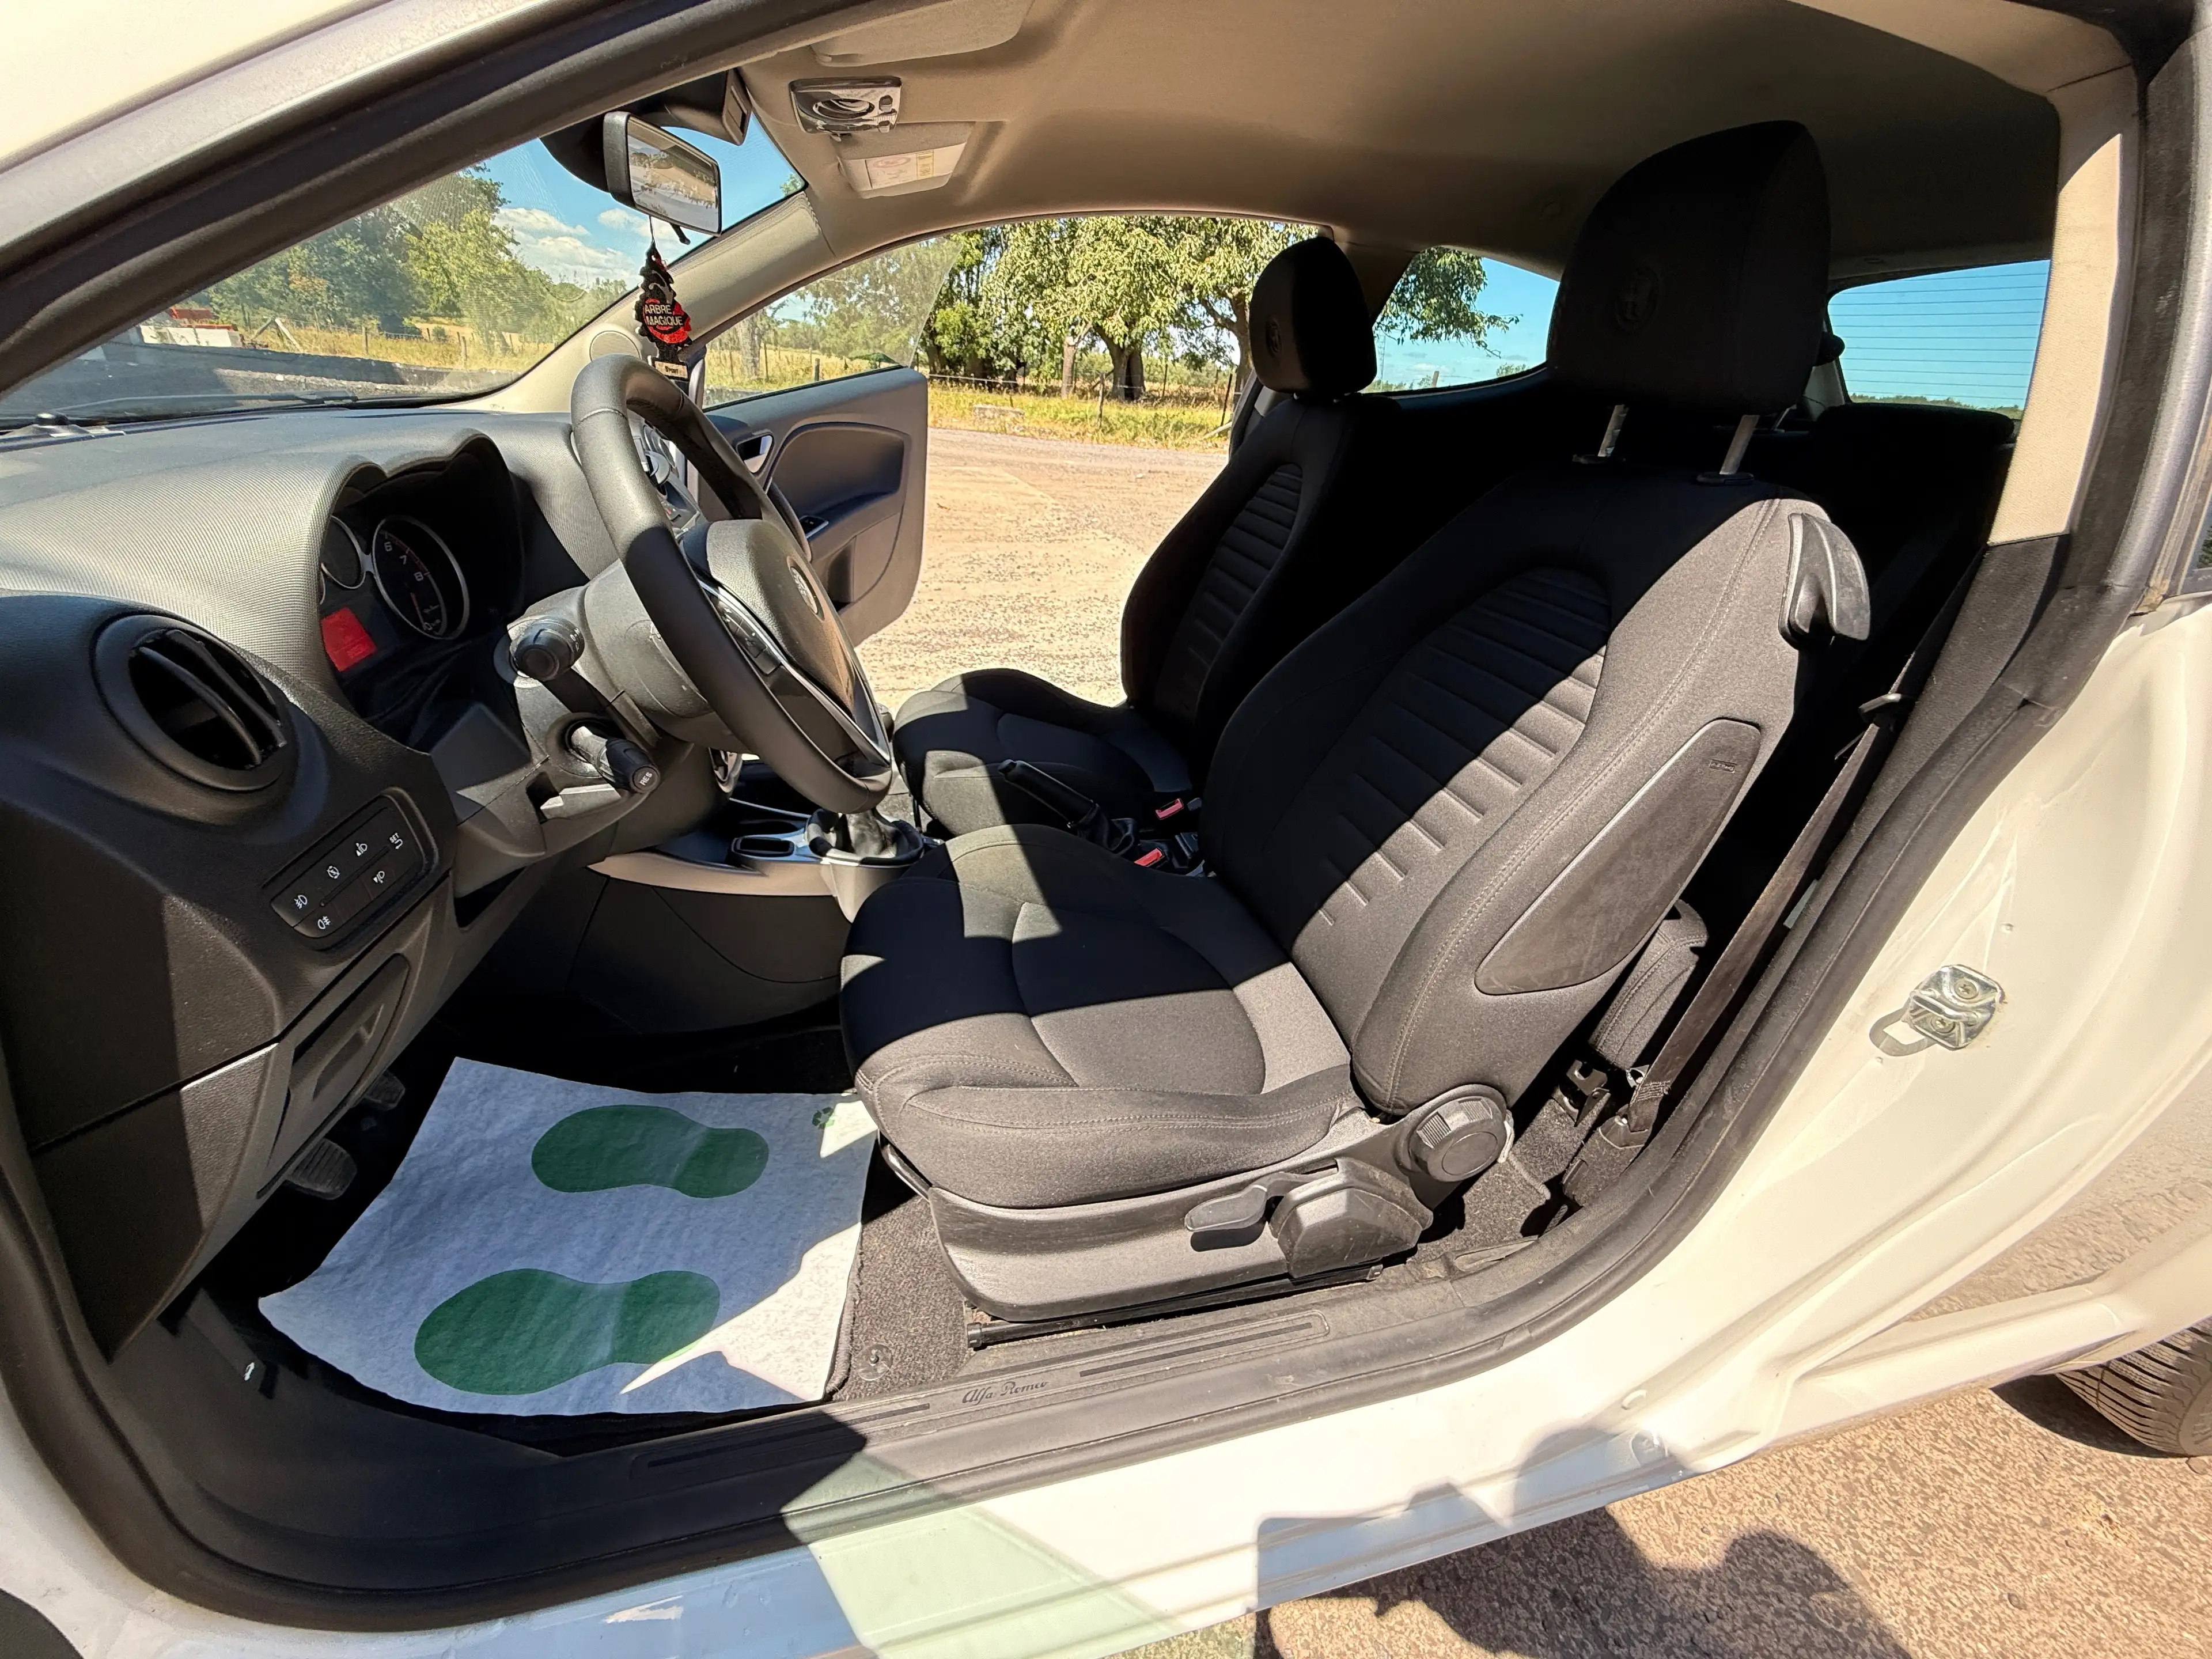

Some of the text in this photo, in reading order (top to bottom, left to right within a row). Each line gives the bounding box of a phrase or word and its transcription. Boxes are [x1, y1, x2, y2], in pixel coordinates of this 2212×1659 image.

[645, 304, 672, 315] ARBRE
[646, 316, 684, 325] MAGIQUE
[384, 541, 392, 552] 6
[399, 555, 407, 565] 7
[414, 571, 424, 581] 8
[639, 772, 653, 786] RES
[389, 832, 399, 843] SET
[962, 1381, 1049, 1406] Alfa Romeo
